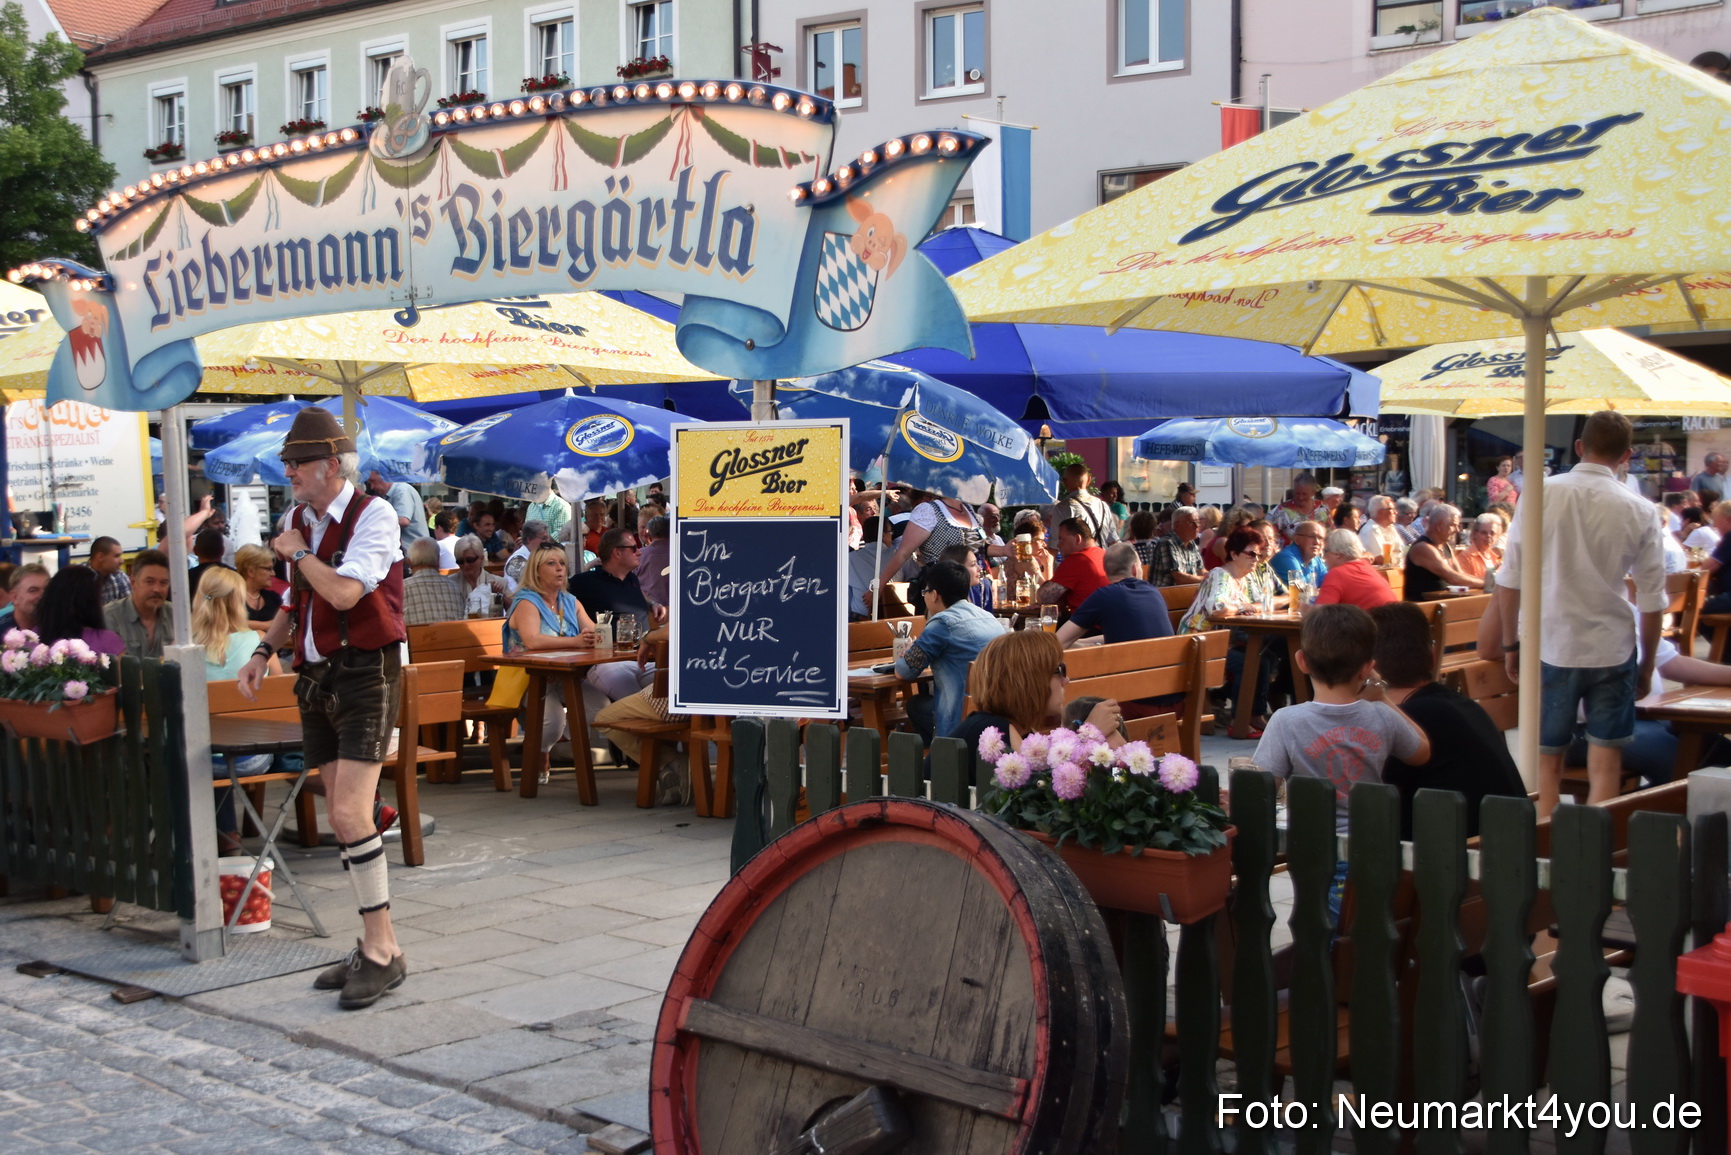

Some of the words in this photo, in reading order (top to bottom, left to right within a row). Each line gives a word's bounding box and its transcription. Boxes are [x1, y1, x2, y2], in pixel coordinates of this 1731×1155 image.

[1178, 112, 1644, 245] Glossner
[1369, 175, 1584, 217] Bier
[440, 165, 757, 284] Biergärtla
[1099, 251, 1177, 275] Der
[1183, 231, 1355, 265] hochfeine
[1375, 222, 1640, 252] Biergenuss
[496, 306, 590, 338] Bier
[382, 328, 433, 344] Der
[439, 329, 534, 348] hochfeine
[541, 333, 652, 358] Biergenuss
[575, 420, 616, 446] Glossner
[975, 423, 1014, 450] WOLKE
[1353, 422, 1378, 437] ACKL
[90, 456, 114, 467] Weine
[709, 438, 809, 497] Glossner
[761, 470, 807, 494] Bier
[693, 498, 715, 512] Der
[717, 498, 763, 515] hochfeine
[766, 498, 825, 515] Biergenuss
[687, 556, 829, 617] Biergarten
[717, 617, 779, 643] NUR
[723, 651, 826, 689] Service
[1304, 726, 1345, 760] SUNSET
